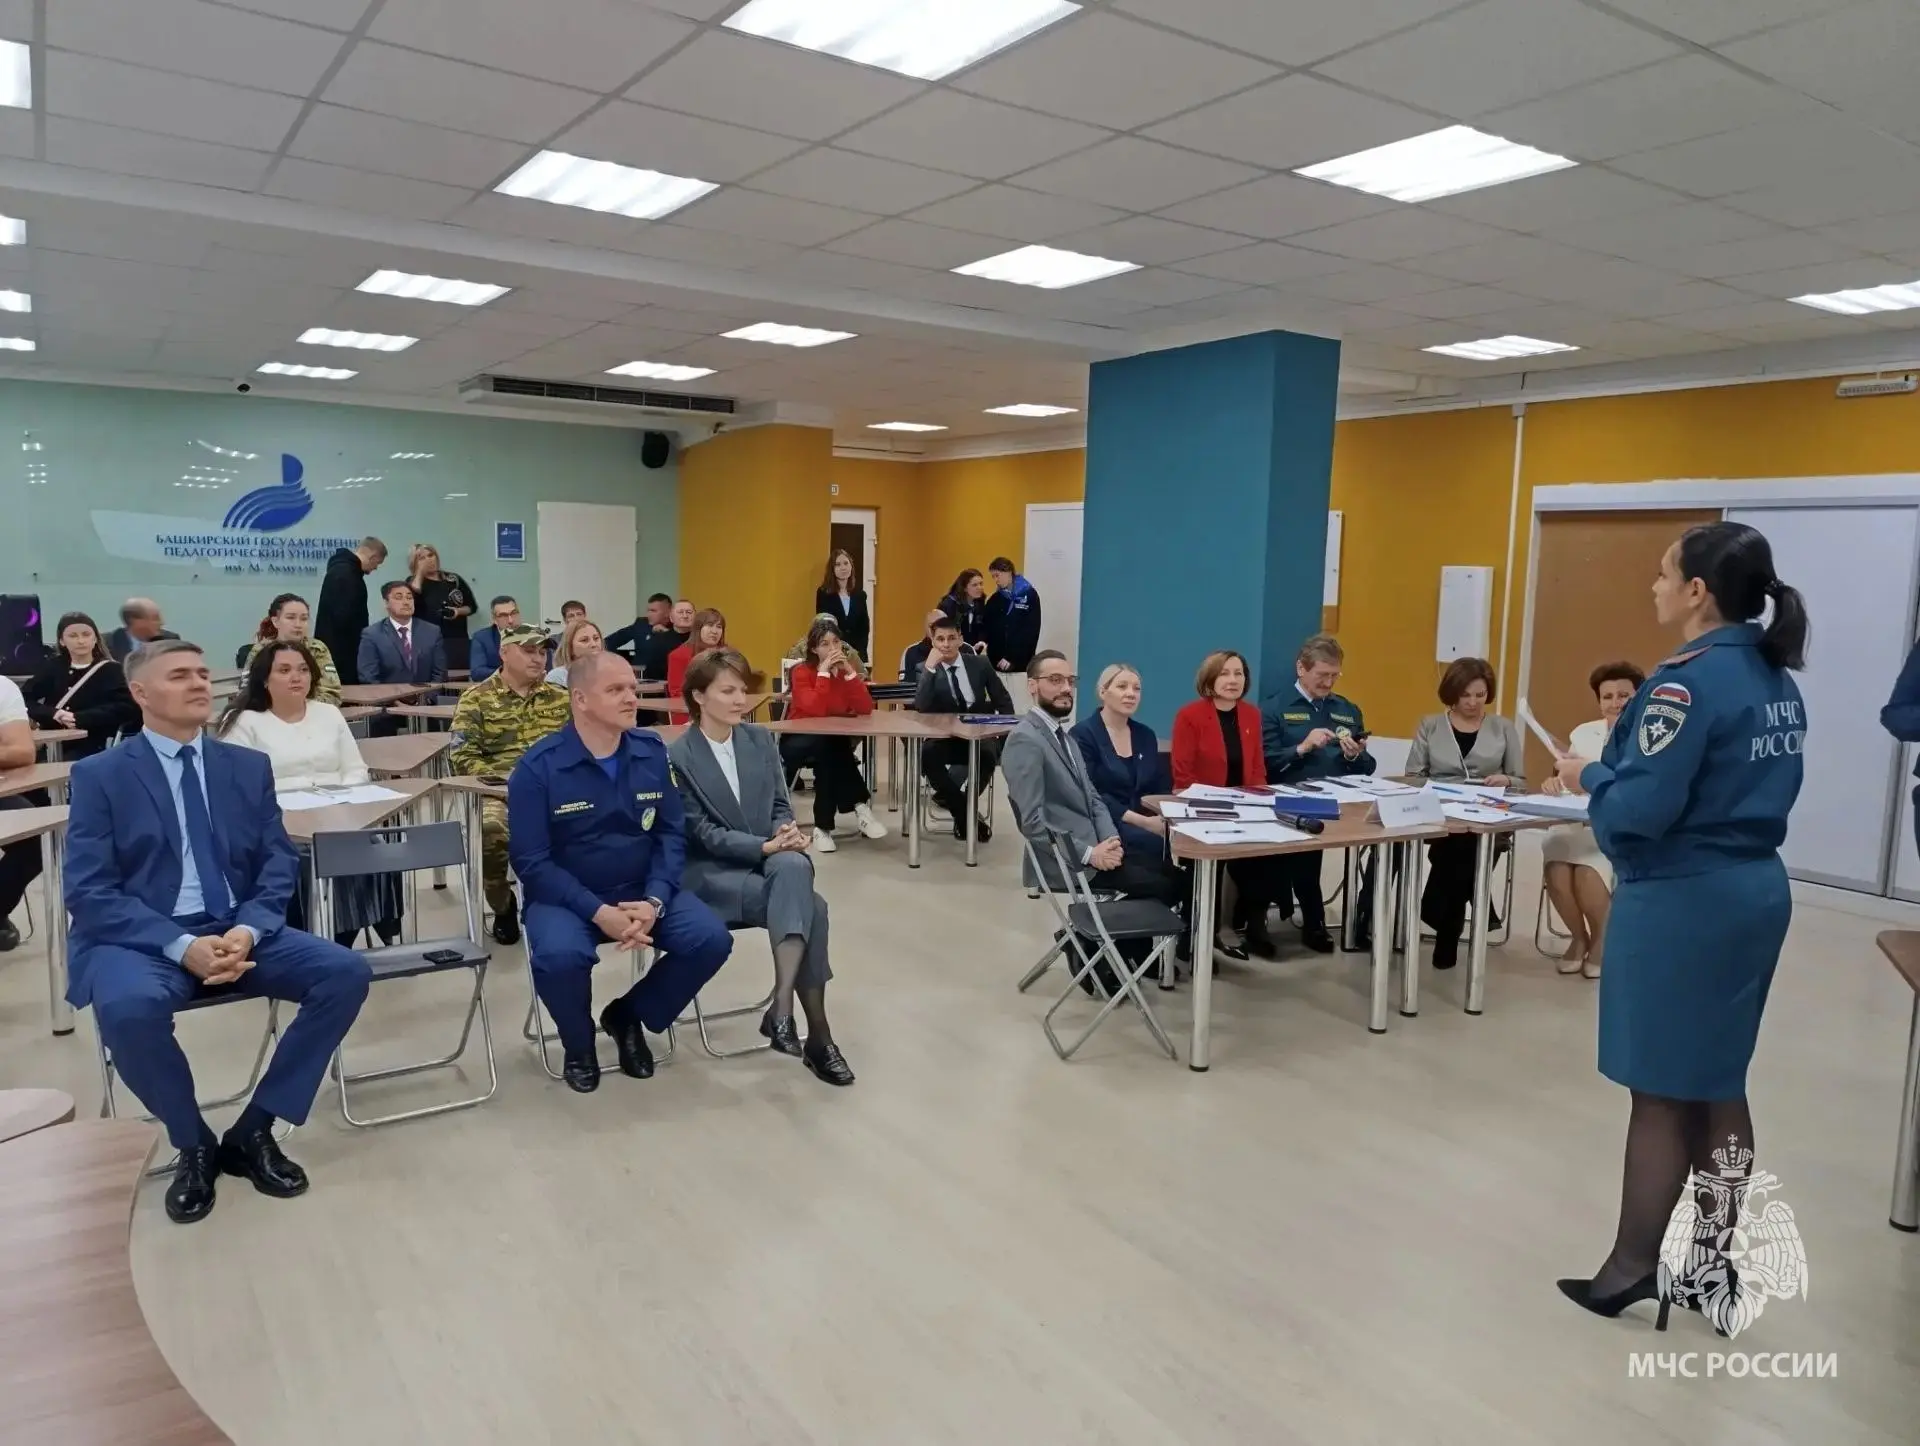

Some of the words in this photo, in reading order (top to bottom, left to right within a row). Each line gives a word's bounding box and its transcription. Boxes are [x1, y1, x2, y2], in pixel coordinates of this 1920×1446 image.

[156, 534, 250, 546] БАШКИРСКИЙ
[254, 537, 360, 548] ГОСУДАРСТВЕНН
[164, 547, 284, 558] ПЕДАГОГИЧЕСКИЙ
[289, 548, 335, 560] УНИВЕР
[225, 564, 245, 572] им.
[248, 563, 264, 572] М.
[1765, 701, 1801, 727] МЧС
[1749, 730, 1807, 761] РОССИ
